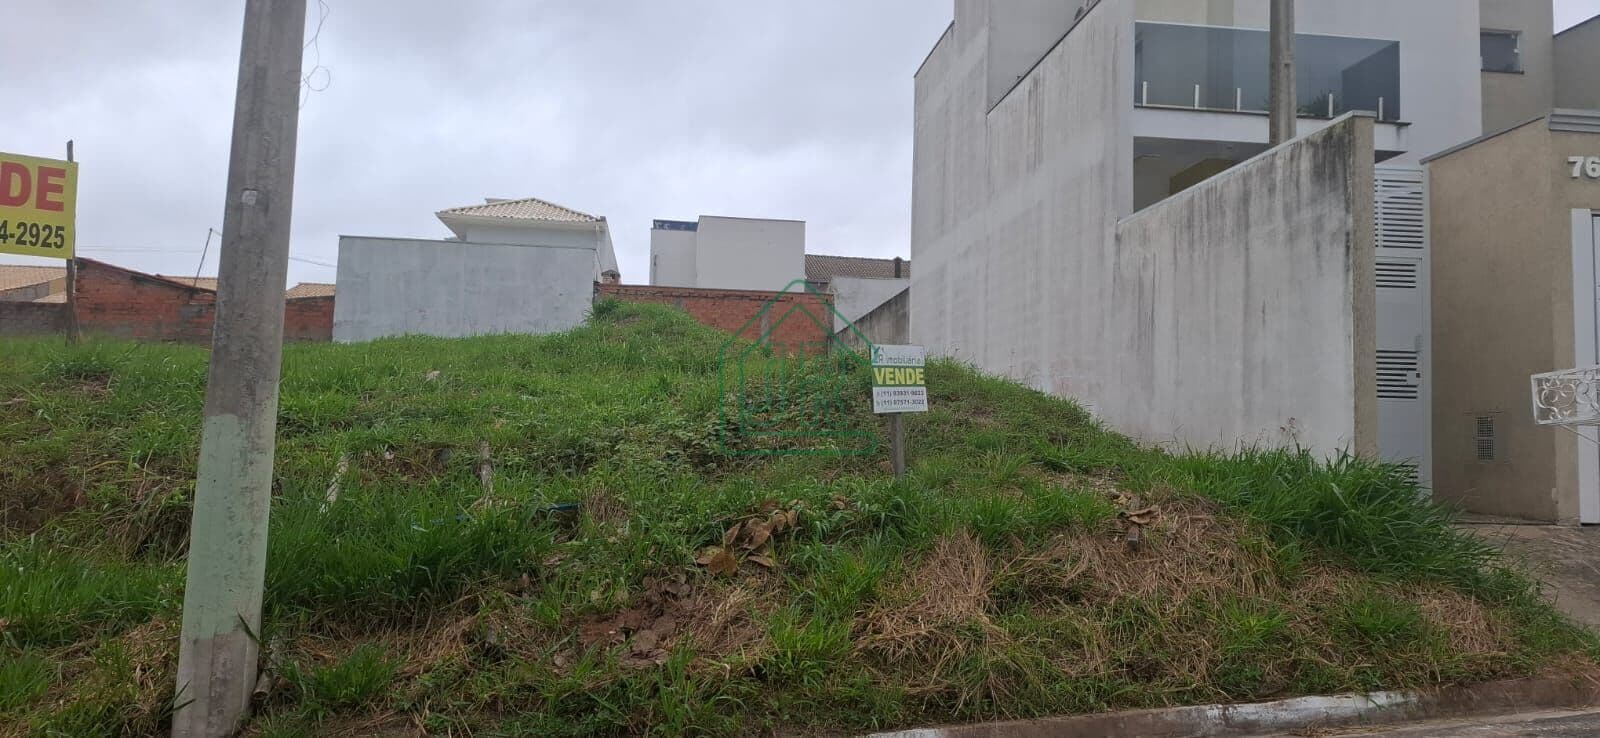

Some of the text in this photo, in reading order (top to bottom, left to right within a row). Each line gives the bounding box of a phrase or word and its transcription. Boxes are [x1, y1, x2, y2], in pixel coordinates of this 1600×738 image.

[1568, 156, 1600, 178] 76
[0, 161, 66, 212] DE
[0, 219, 65, 249] 4-2925
[873, 367, 925, 385] VENDE
